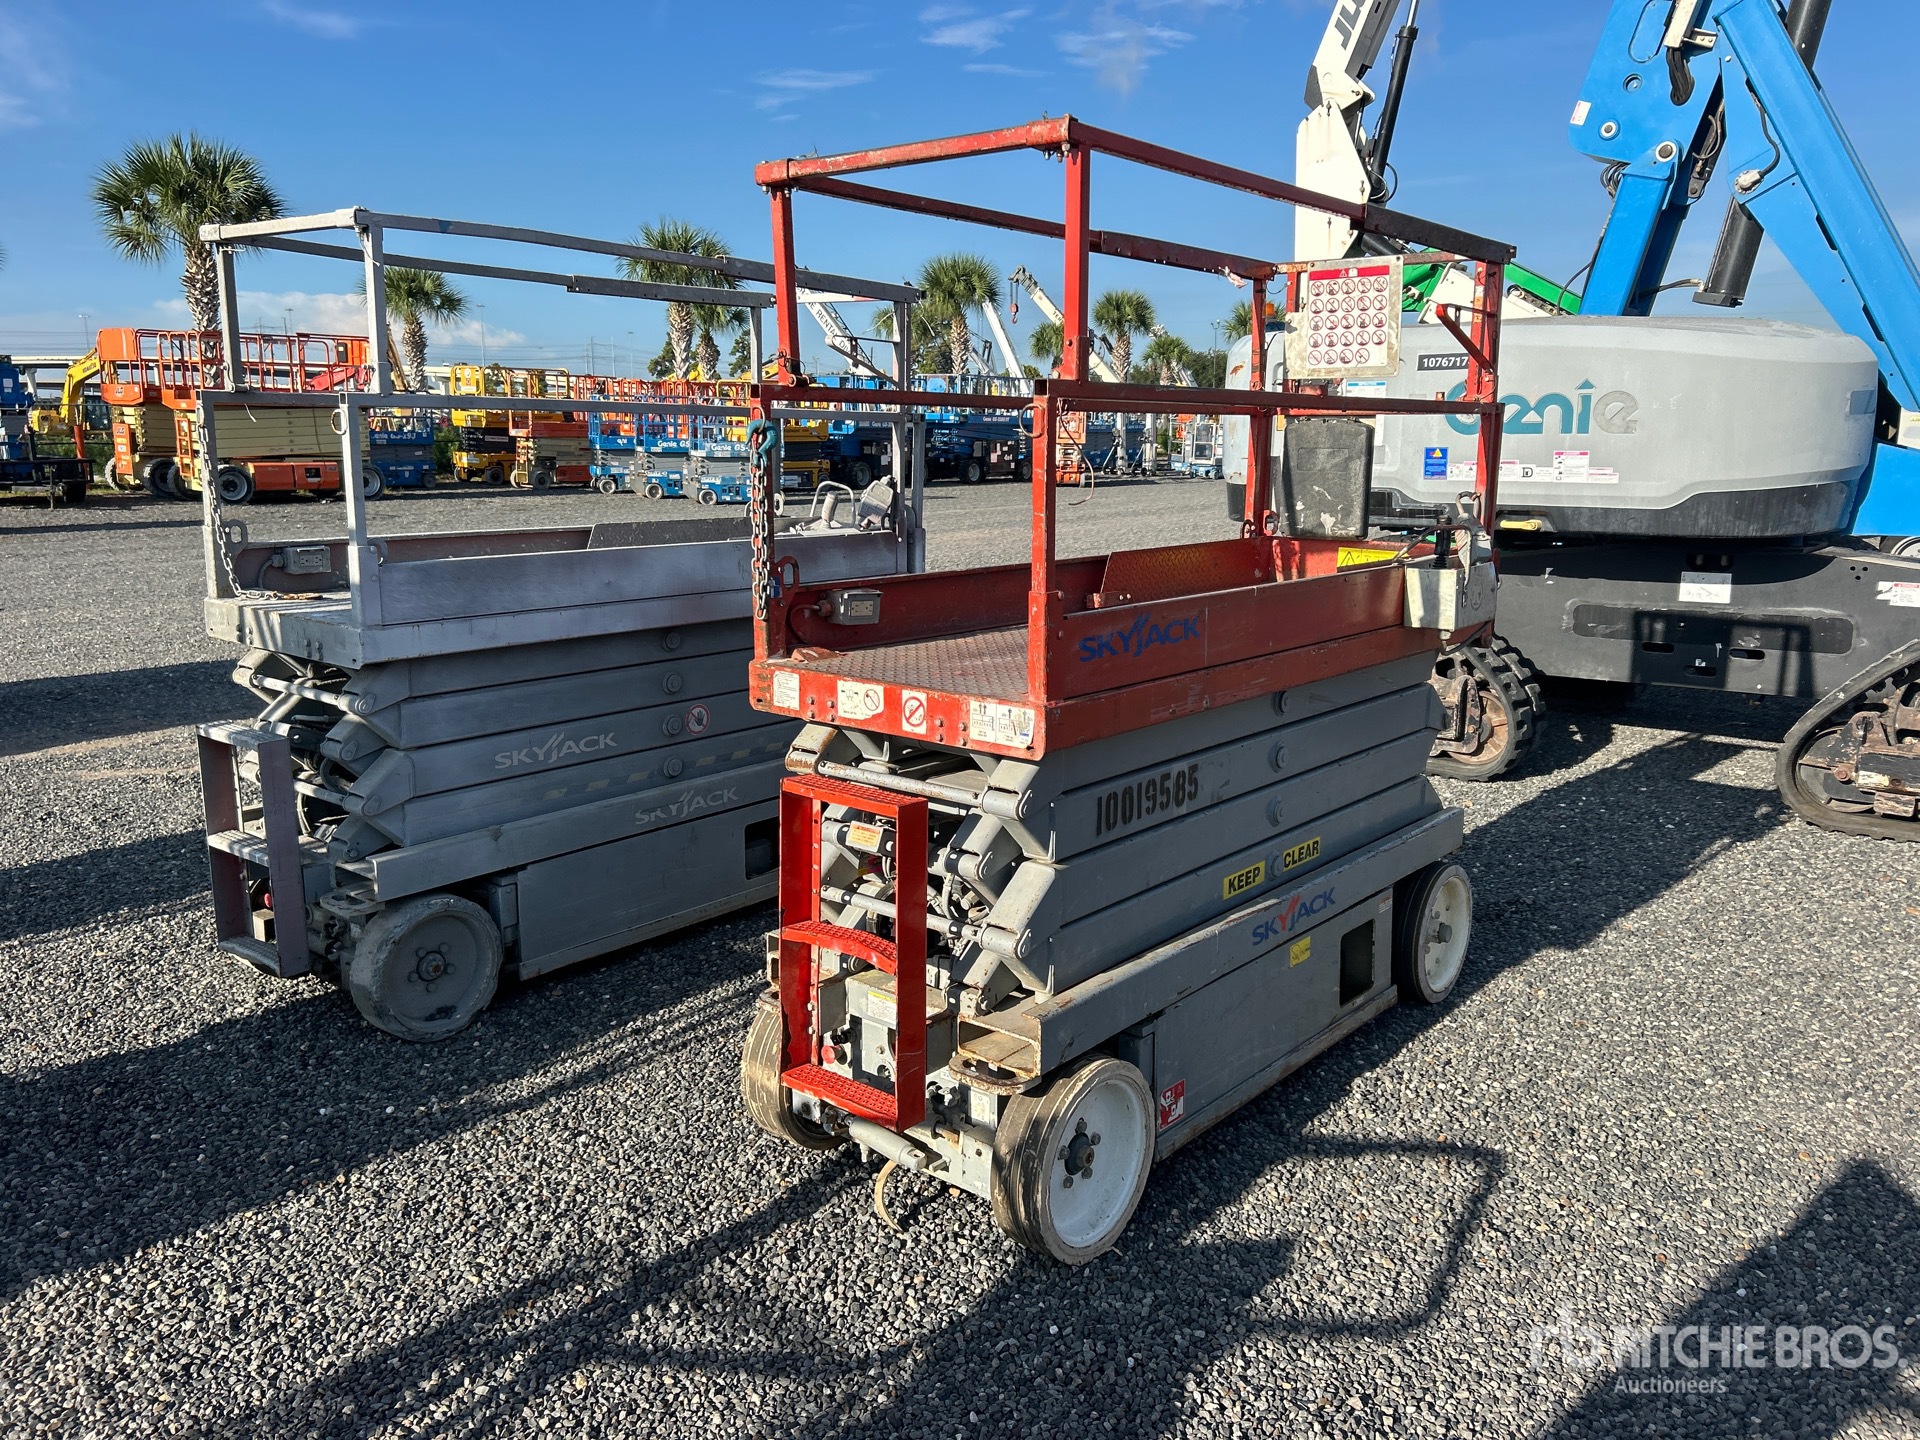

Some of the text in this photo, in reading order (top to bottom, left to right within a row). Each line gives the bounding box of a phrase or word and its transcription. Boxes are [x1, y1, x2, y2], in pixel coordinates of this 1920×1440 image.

[1422, 356, 1470, 369] 1076717
[657, 440, 690, 448] Genie GS
[711, 443, 732, 451] Genie
[1078, 611, 1200, 662] SKYJACK
[494, 731, 618, 769] SKYJACK
[1096, 763, 1199, 836] 10019585
[1228, 840, 1319, 895] KEEP CLEAR
[1252, 887, 1336, 946] SKYJACK
